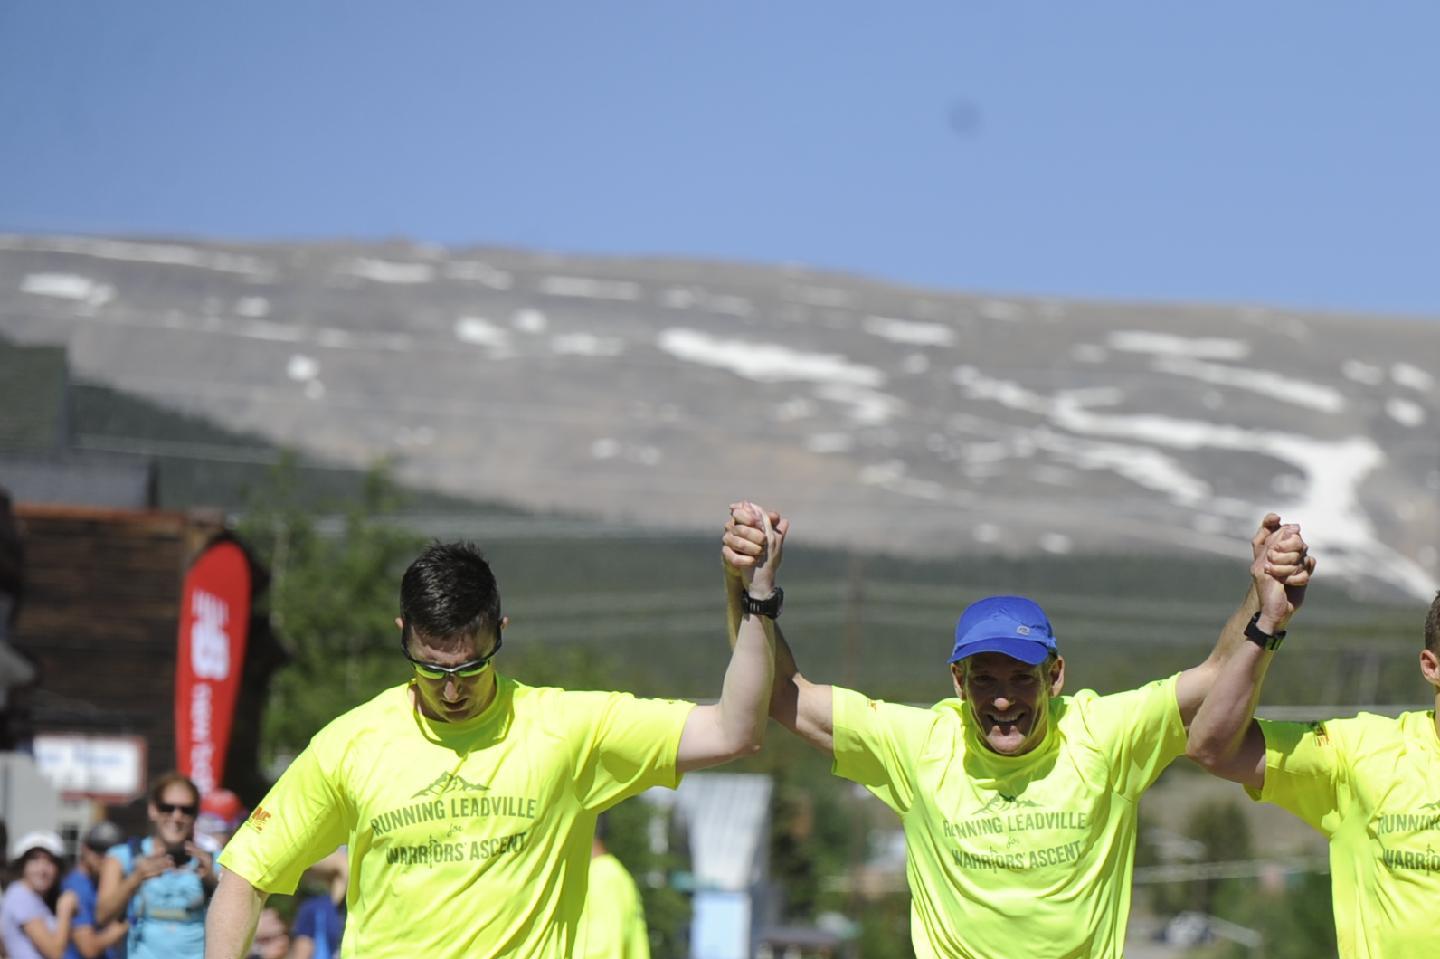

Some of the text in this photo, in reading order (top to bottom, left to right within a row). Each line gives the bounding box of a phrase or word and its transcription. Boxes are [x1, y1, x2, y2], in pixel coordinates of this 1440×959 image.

[370, 796, 537, 836] RUNNING LEADVILLE
[1007, 811, 1087, 832] LEADVILLE
[469, 832, 528, 861] ASCENT
[1029, 840, 1082, 870] ASCENT
